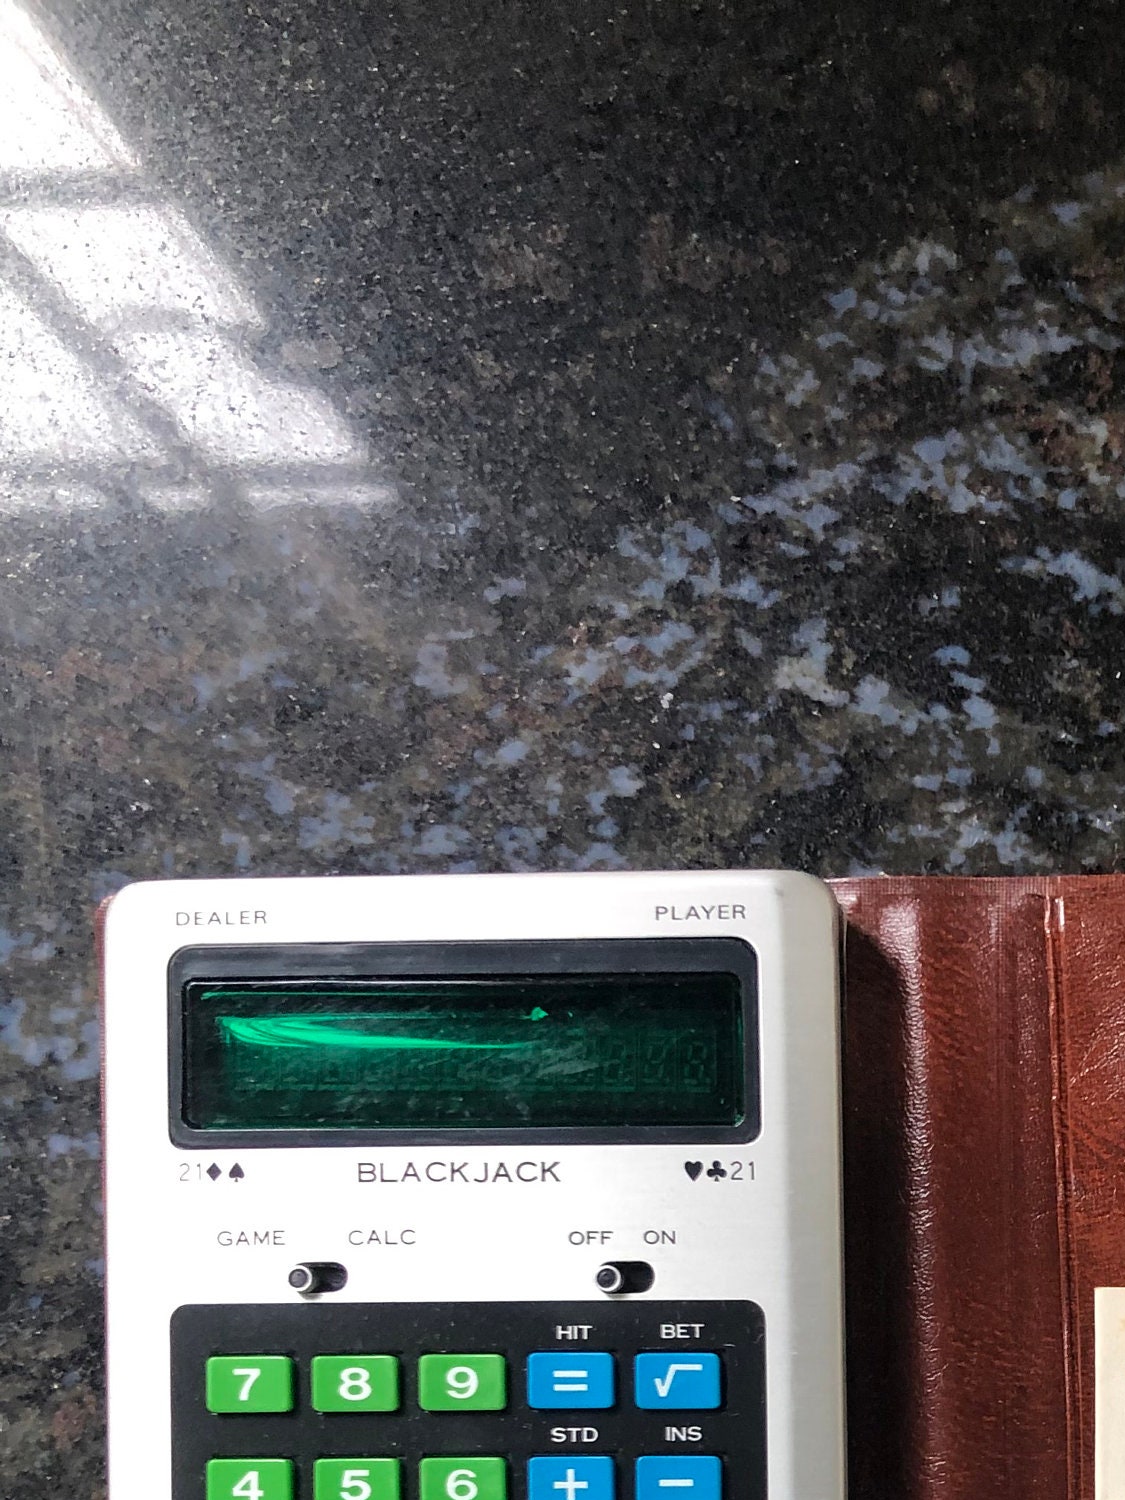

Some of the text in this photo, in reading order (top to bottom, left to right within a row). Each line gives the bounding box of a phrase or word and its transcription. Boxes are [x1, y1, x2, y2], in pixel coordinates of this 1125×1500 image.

[176, 910, 267, 926] DEALER
[655, 904, 746, 921] PLAYER
[179, 1162, 201, 1182] 21
[358, 1161, 561, 1183] BLACKJACK
[730, 1161, 755, 1180] 21
[217, 1230, 285, 1246] GAME
[349, 1229, 416, 1246] CALC
[568, 1231, 614, 1245] OFF
[643, 1230, 676, 1245] ON
[556, 1325, 593, 1340] HIT
[660, 1324, 705, 1339] BET
[232, 1368, 261, 1401] 7
[338, 1367, 372, 1401] 8
[446, 1366, 478, 1399] 9
[551, 1427, 598, 1442] STD
[665, 1426, 702, 1441] INS
[446, 1469, 478, 1500] 6
